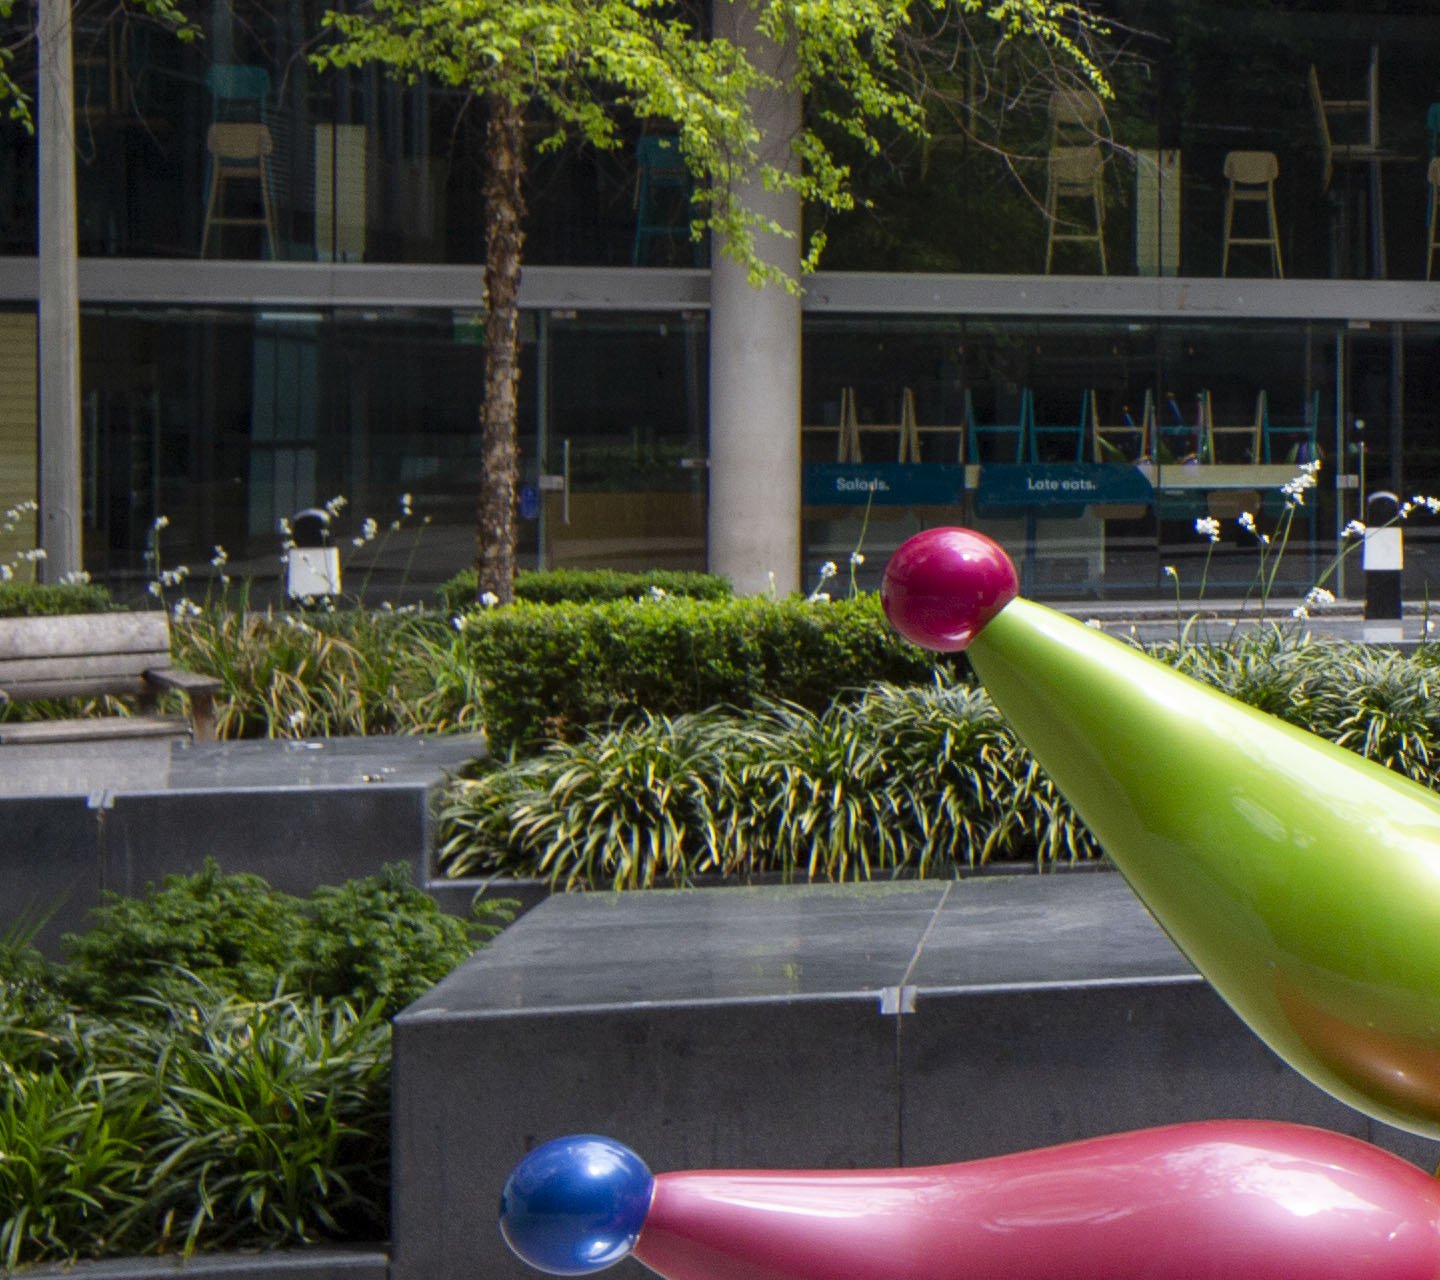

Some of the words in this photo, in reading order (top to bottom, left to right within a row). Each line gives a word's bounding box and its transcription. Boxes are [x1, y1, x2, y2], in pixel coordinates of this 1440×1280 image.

[836, 477, 890, 491] Salads.
[1027, 477, 1060, 491] Late
[1061, 478, 1096, 491] eats.
